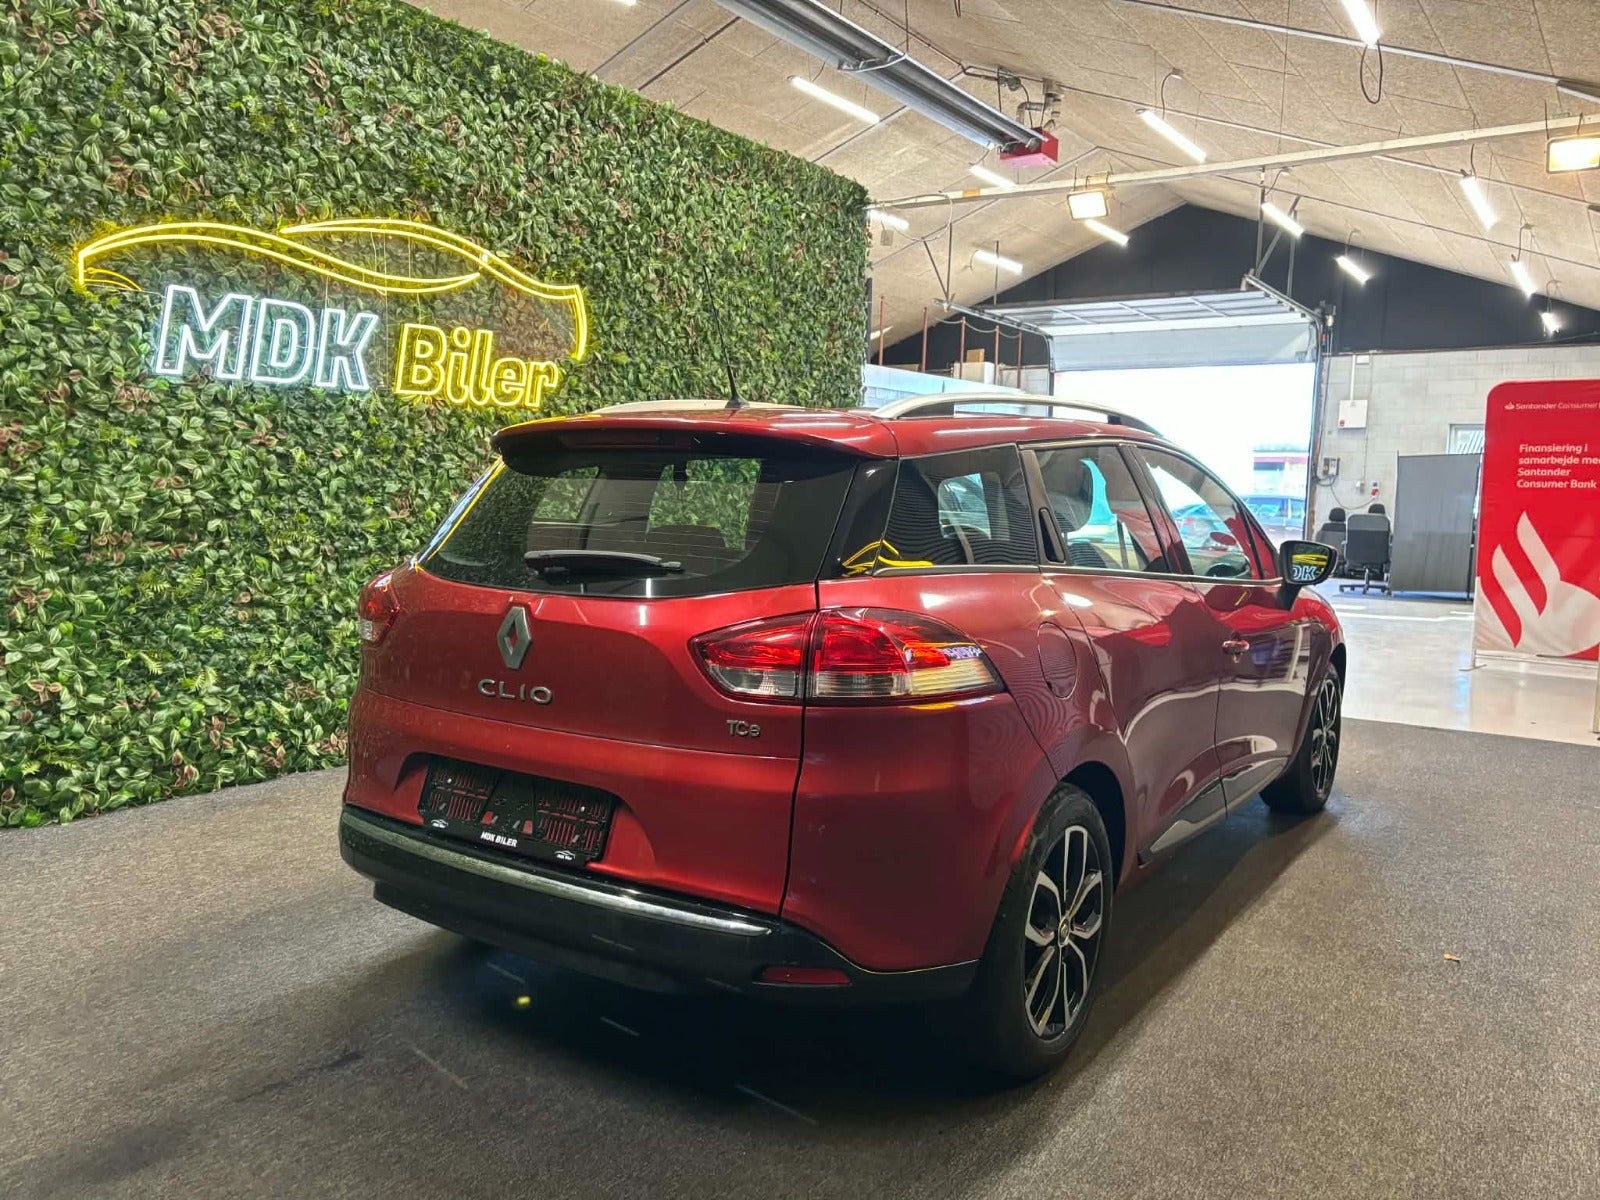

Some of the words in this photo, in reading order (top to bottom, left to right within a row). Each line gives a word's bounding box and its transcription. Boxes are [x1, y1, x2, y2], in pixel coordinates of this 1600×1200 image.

[153, 283, 379, 391] MDK
[394, 322, 559, 407] Biler
[1515, 402, 1556, 410] Santander
[1519, 443, 1582, 455] Finansiering
[1518, 455, 1580, 466] samarbejde
[1581, 456, 1600, 465] me
[1517, 467, 1571, 477] Santander
[1516, 479, 1569, 488] Consumer
[1570, 479, 1597, 488] Bank
[477, 678, 553, 705] CLIO
[495, 835, 518, 848] BILER
